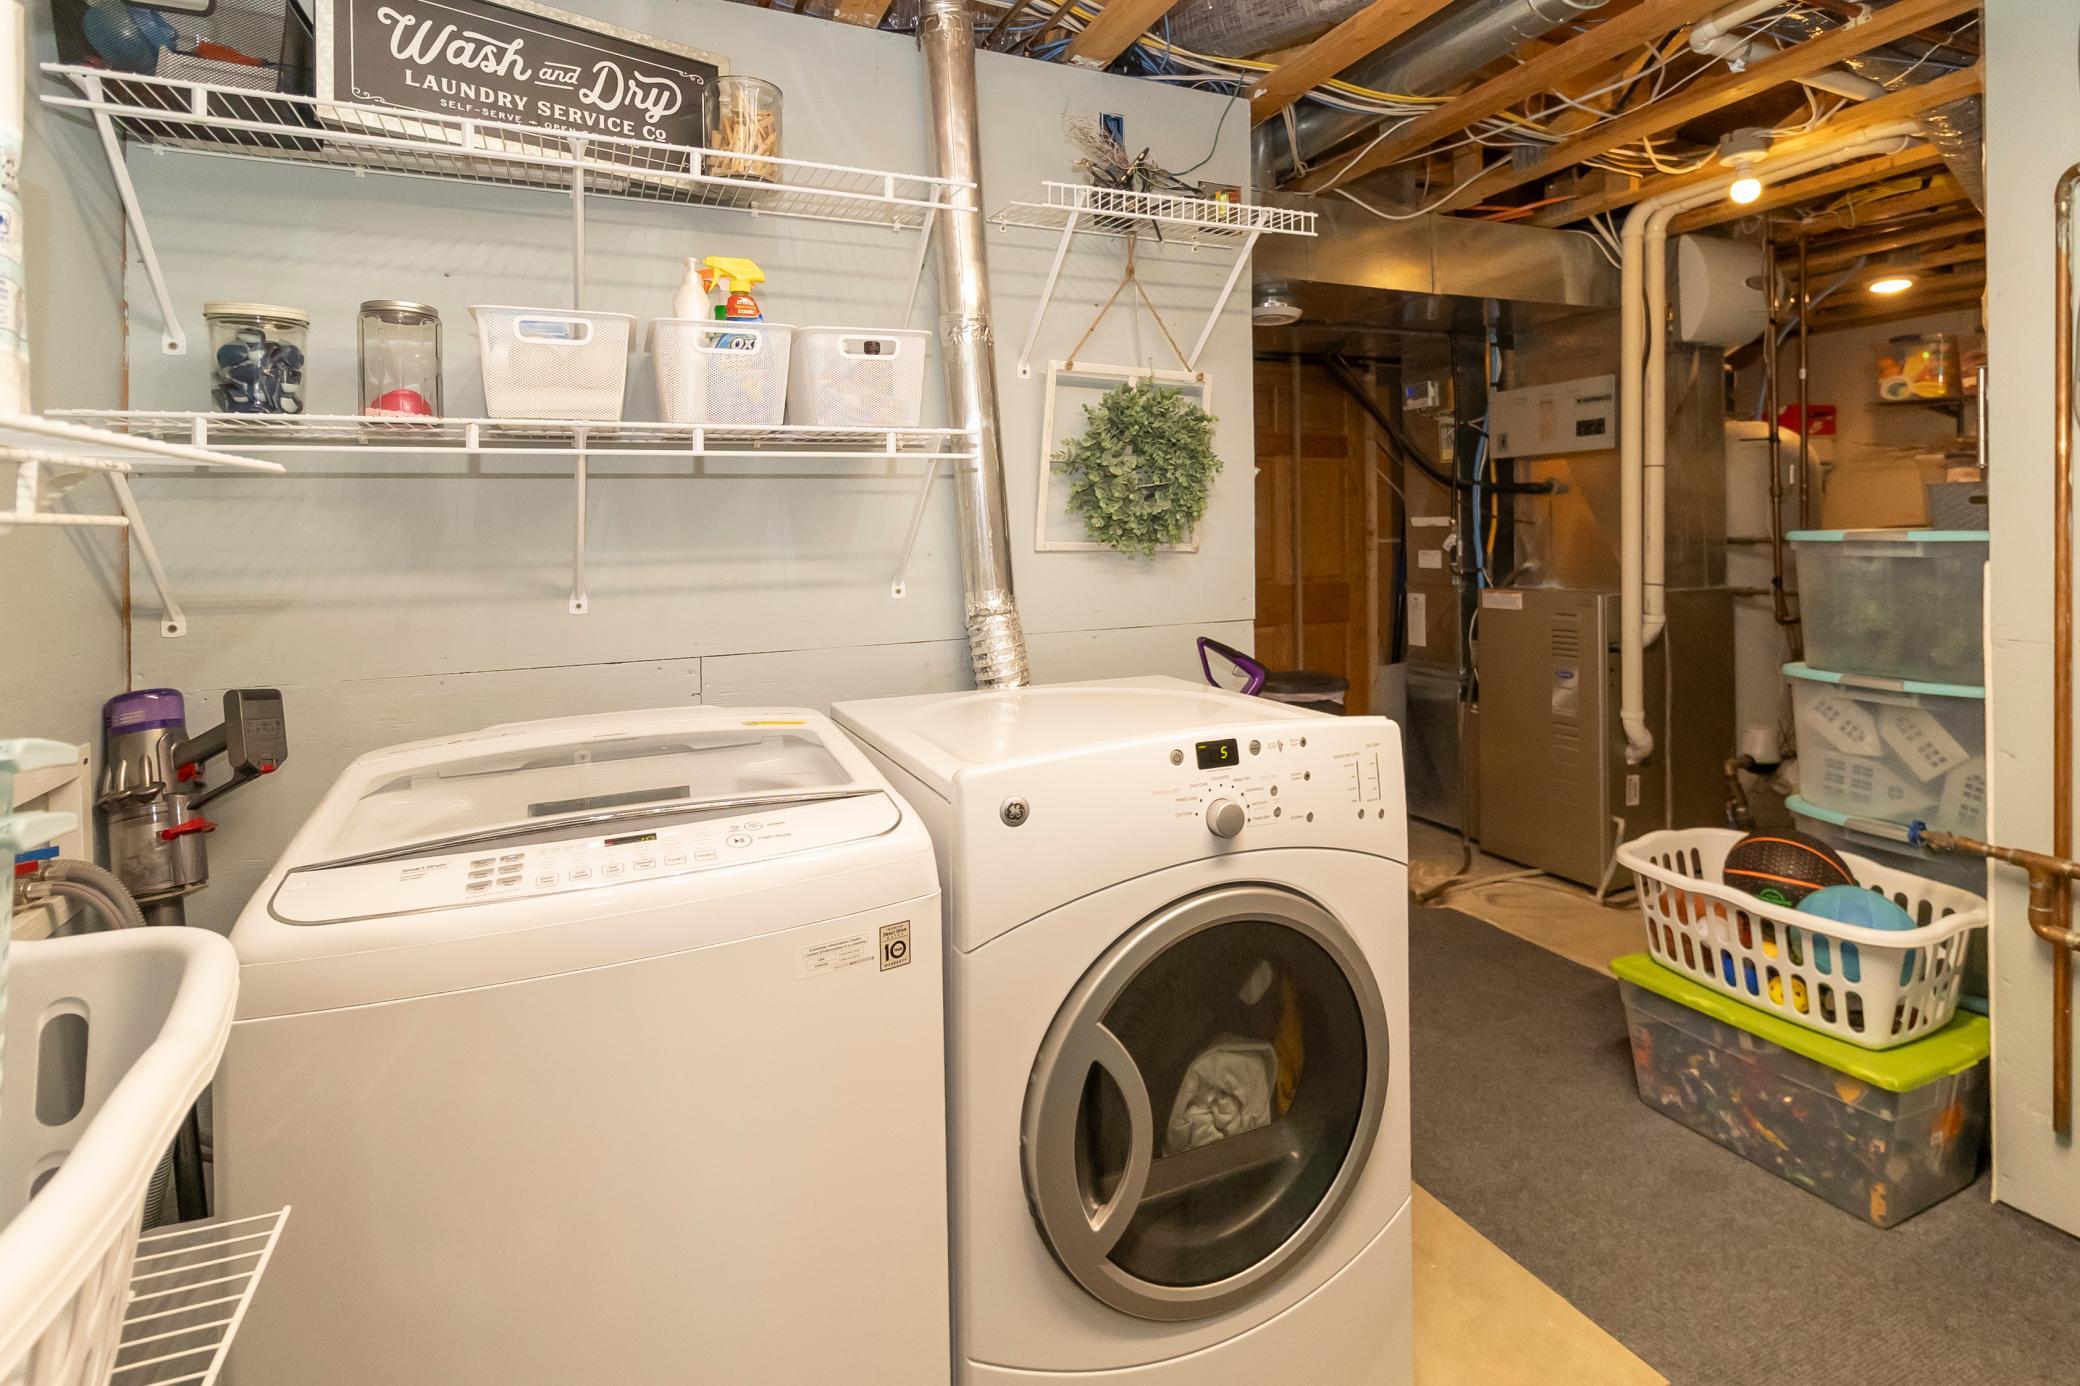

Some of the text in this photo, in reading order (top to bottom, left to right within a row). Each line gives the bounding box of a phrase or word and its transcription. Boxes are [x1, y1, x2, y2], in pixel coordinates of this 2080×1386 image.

[377, 6, 682, 123] Wash and Dry
[404, 68, 528, 112] LAUNDRY
[537, 100, 636, 137] SERVICE
[440, 98, 523, 124] SELF-SERVE
[884, 940, 907, 962] 10
